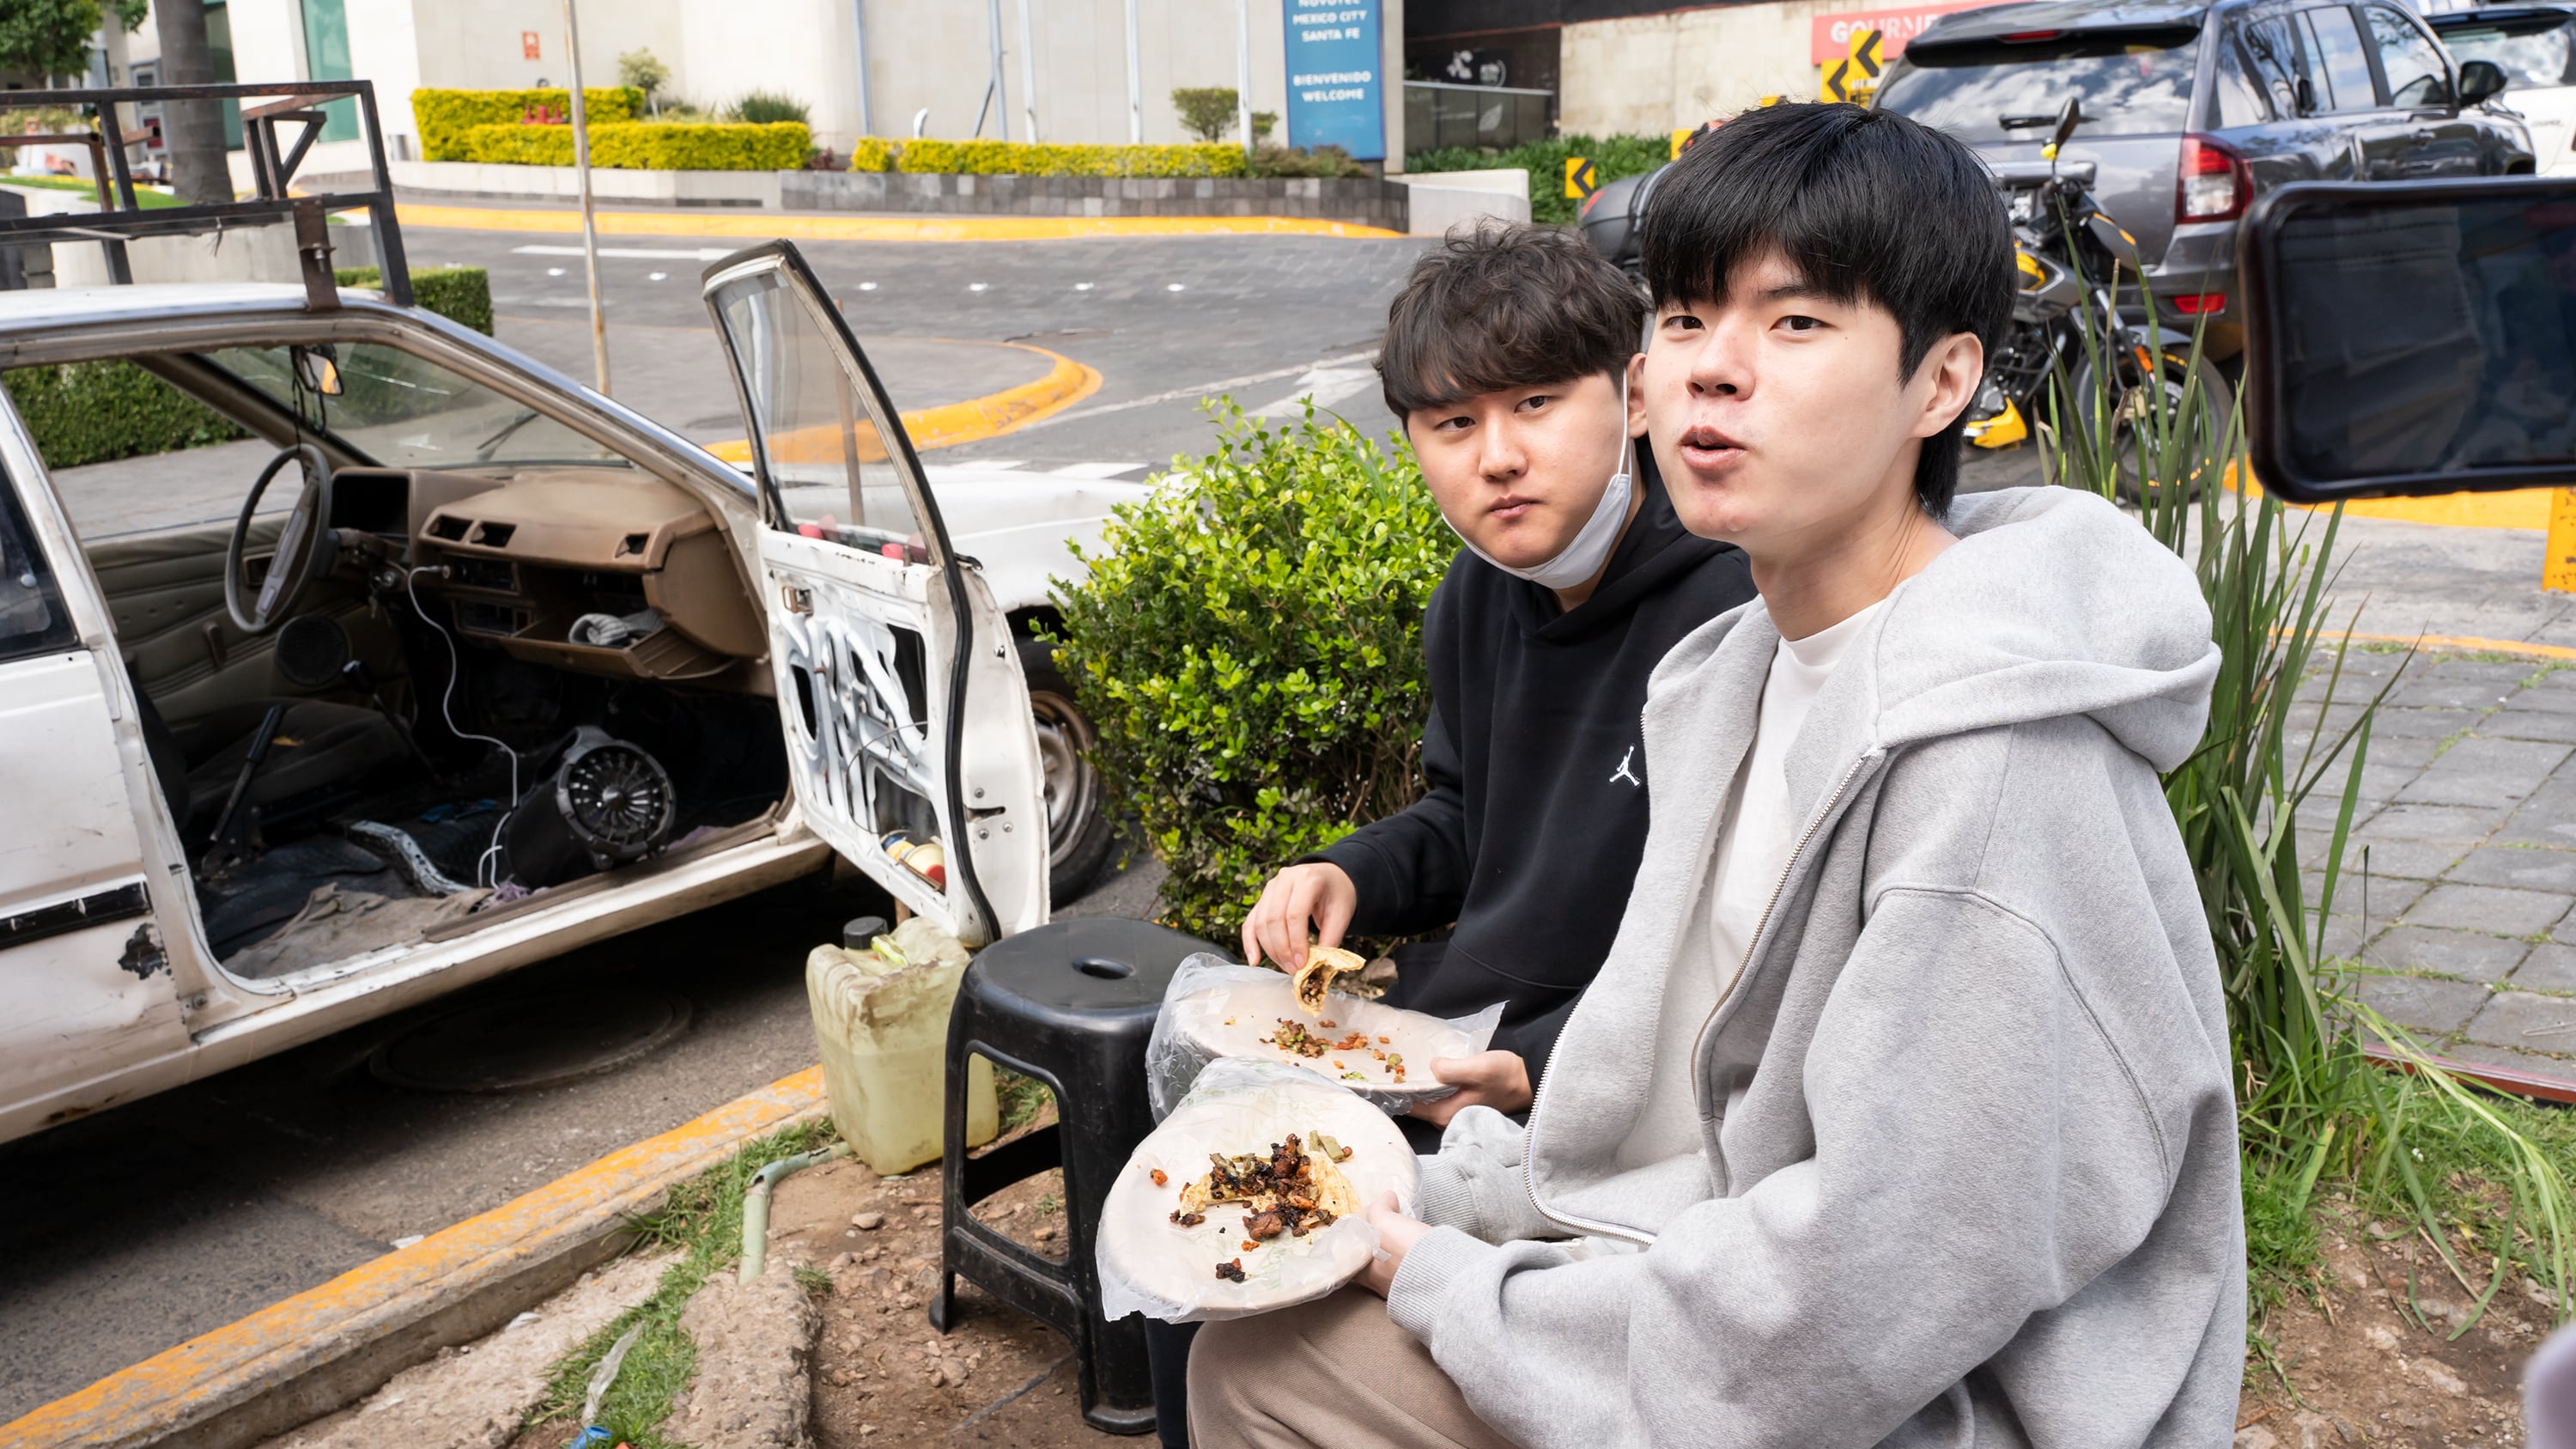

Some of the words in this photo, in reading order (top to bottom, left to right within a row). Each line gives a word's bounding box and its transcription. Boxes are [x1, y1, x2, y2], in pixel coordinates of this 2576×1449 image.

[1292, 12, 1337, 25] MEXICO
[1340, 10, 1367, 22] CITY
[1302, 29, 1342, 42] SANTA
[1345, 27, 1360, 40] FE
[1293, 70, 1372, 86] BIENVENIDO
[1302, 88, 1364, 102] WELCOME
